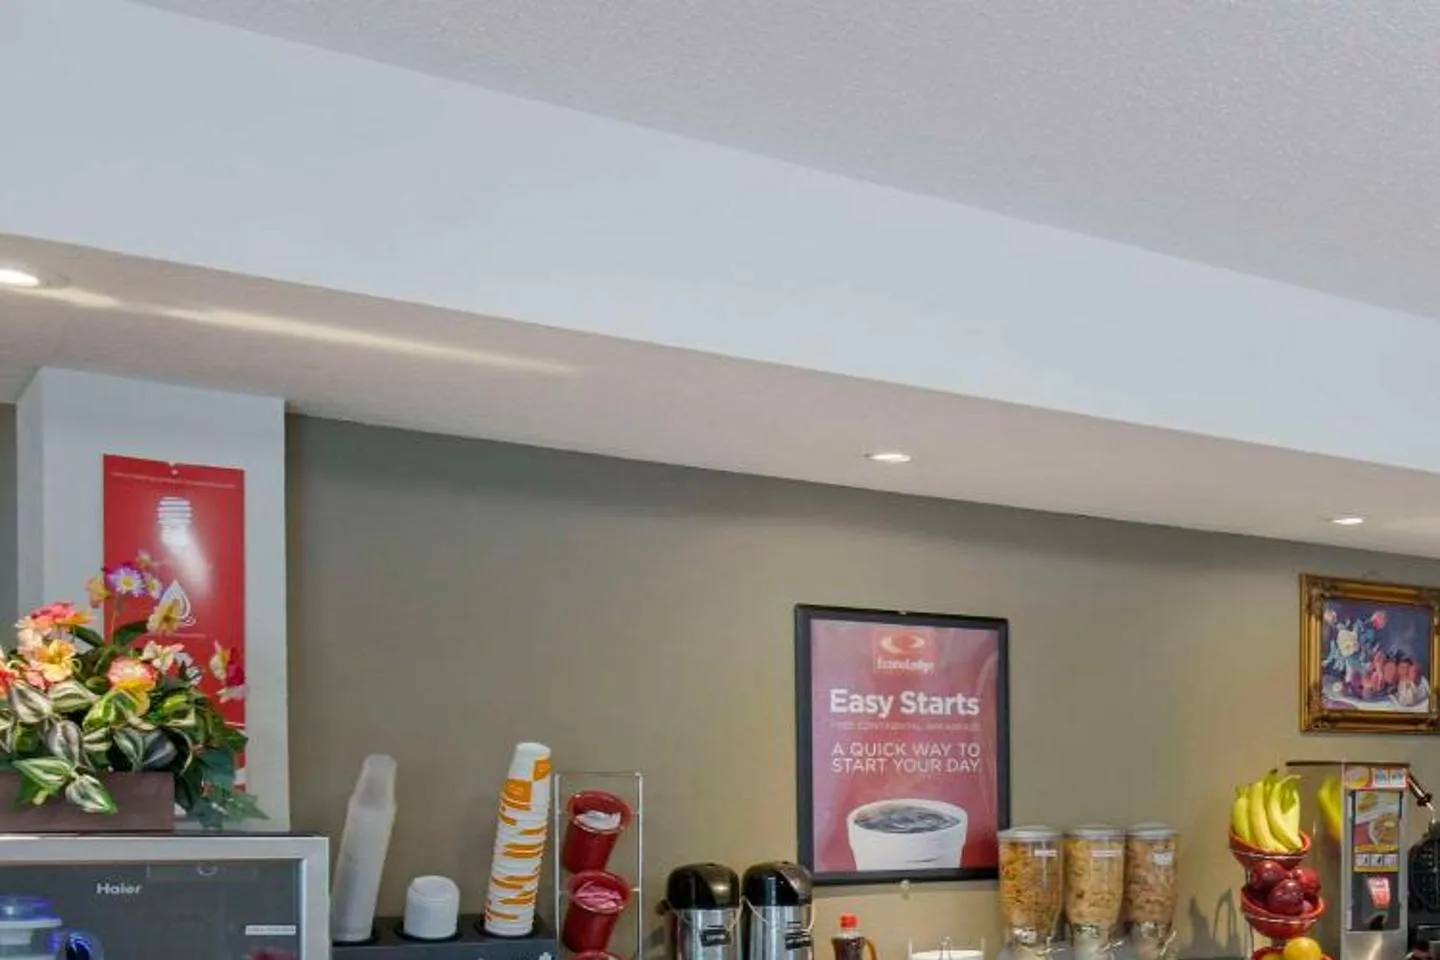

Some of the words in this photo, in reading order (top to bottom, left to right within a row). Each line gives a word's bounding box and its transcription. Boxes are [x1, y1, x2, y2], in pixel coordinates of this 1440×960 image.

[829, 688, 894, 718] Easy
[900, 690, 980, 716] Starts
[831, 741, 845, 757] A
[850, 742, 907, 757] QUICK
[913, 743, 953, 757] WAY
[959, 742, 981, 757] TO
[831, 758, 888, 774] START
[893, 758, 942, 773] YOUR
[96, 883, 142, 894] Haier
